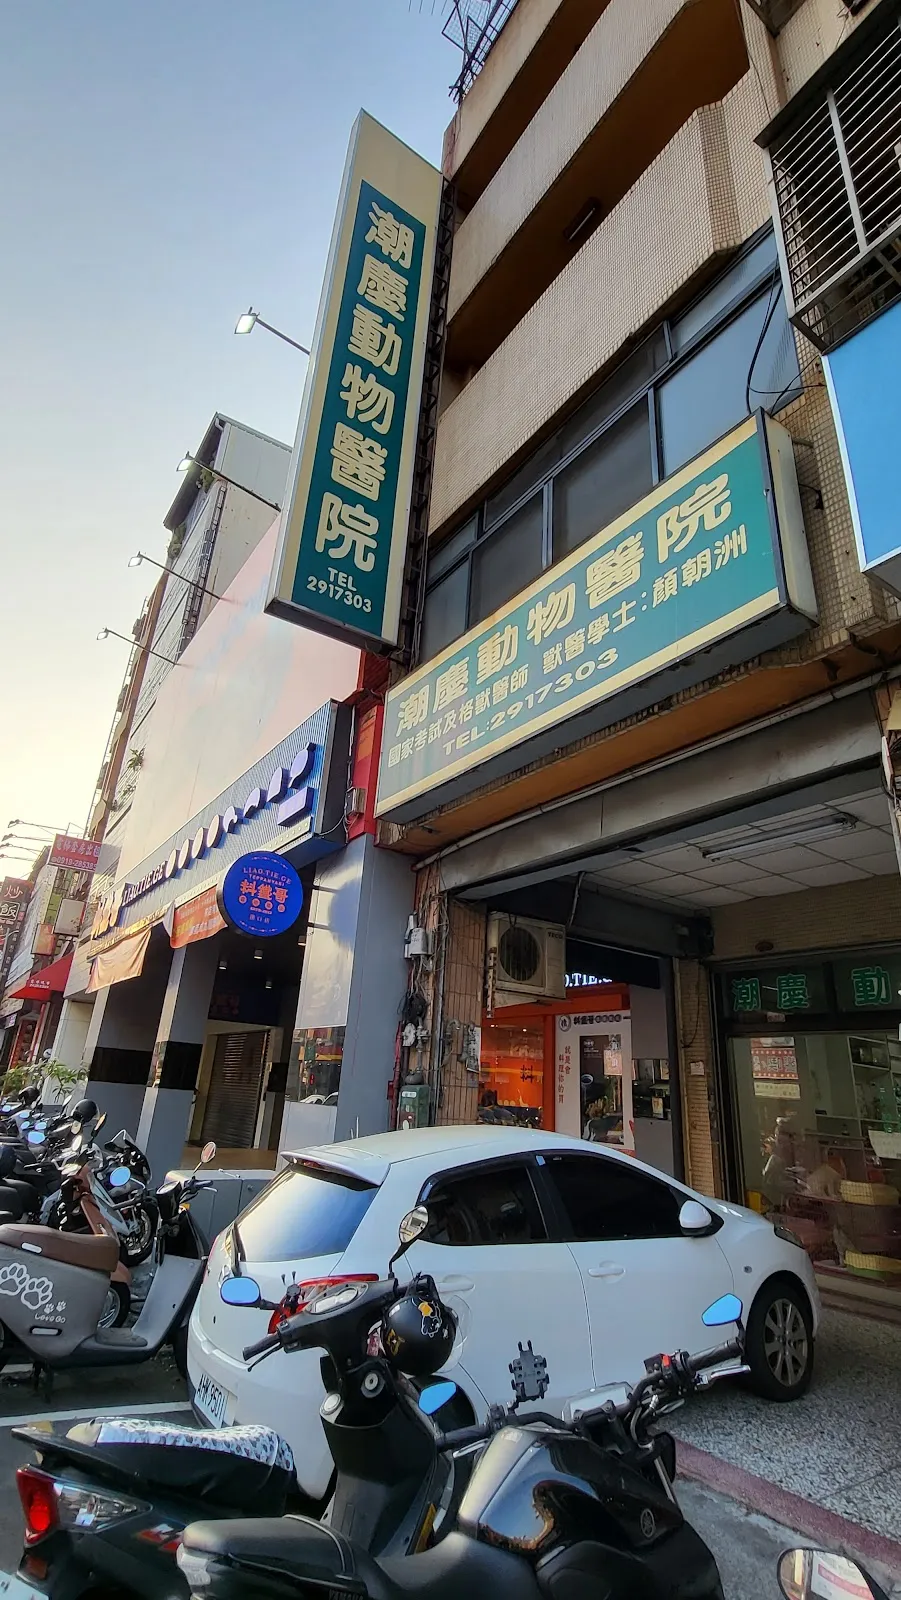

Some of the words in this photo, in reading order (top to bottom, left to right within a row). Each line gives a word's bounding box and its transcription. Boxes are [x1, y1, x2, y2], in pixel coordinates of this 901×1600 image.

[315, 201, 414, 573] 潮慶動物醫院
[306, 575, 372, 613] 2917303
[328, 566, 357, 592] TEL
[396, 473, 732, 738] 潮慶動物醫院
